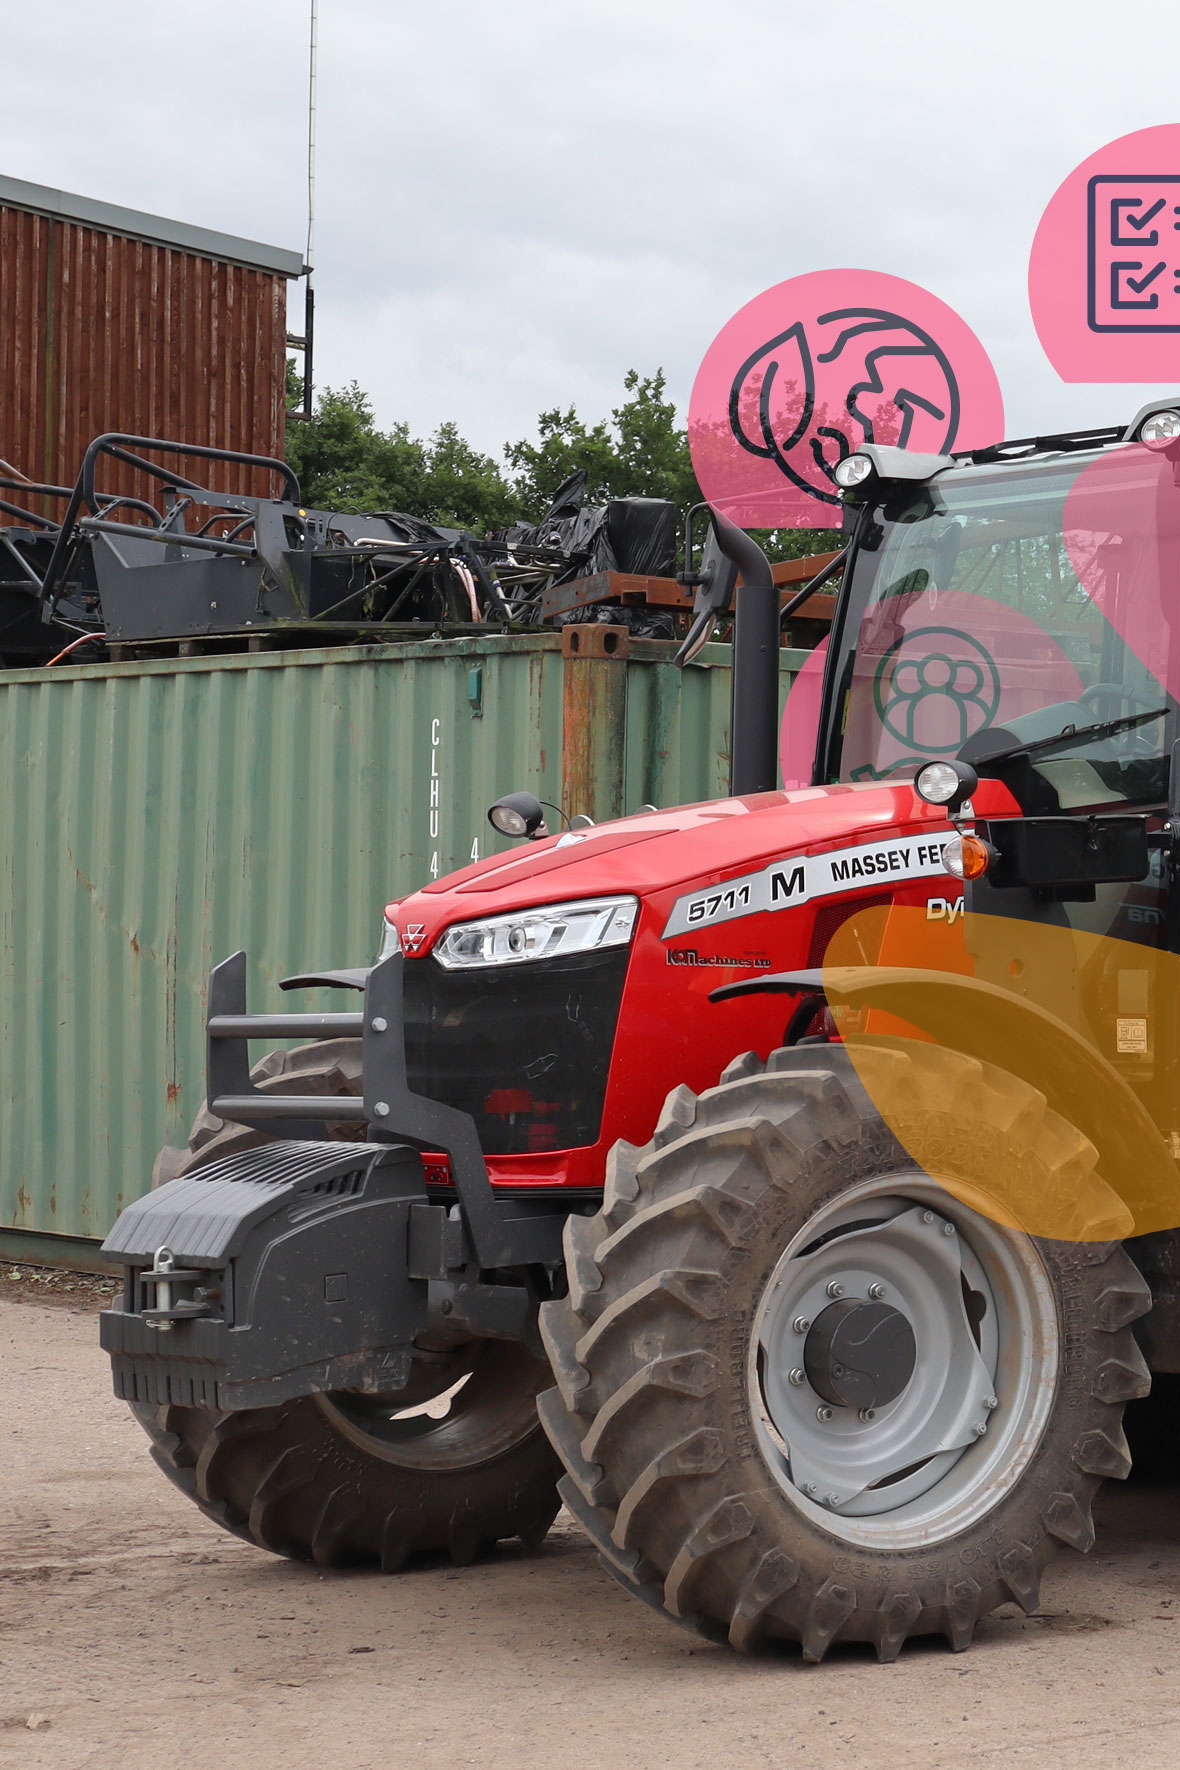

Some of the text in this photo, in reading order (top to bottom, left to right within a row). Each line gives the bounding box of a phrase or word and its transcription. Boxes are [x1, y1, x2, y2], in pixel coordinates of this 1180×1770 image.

[429, 718, 440, 838] CLHU
[687, 882, 751, 924] 5711
[770, 866, 806, 901] M
[831, 848, 910, 881] MASSEY
